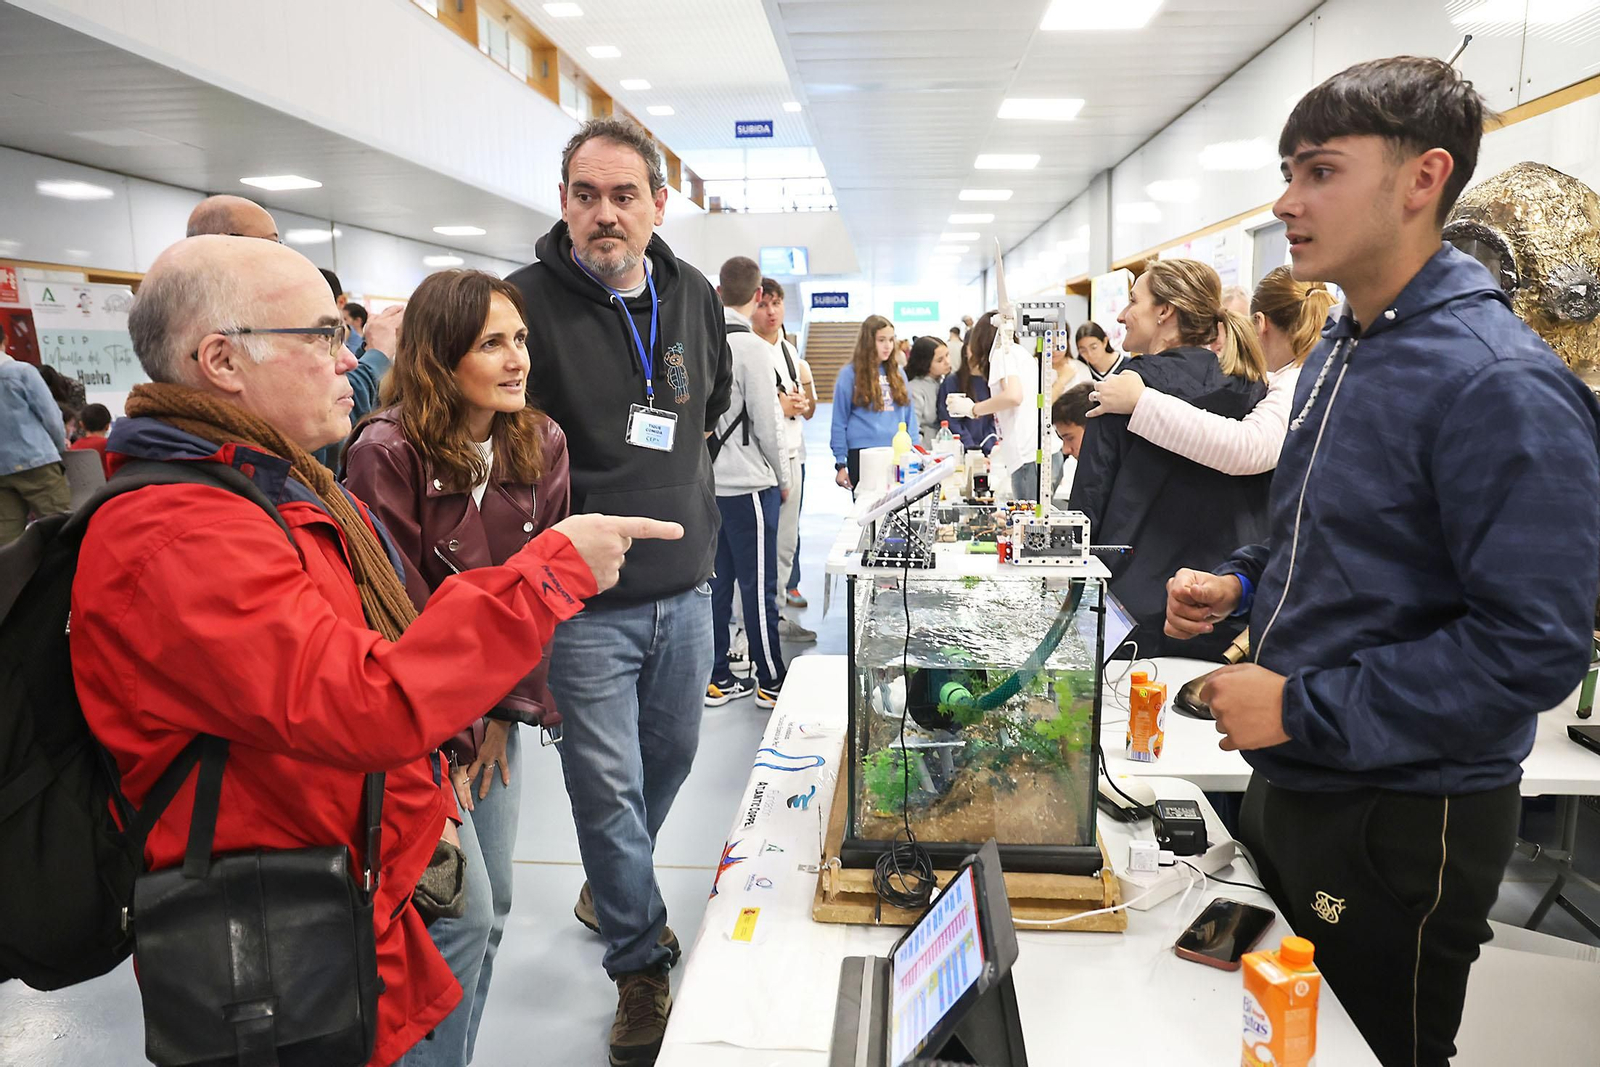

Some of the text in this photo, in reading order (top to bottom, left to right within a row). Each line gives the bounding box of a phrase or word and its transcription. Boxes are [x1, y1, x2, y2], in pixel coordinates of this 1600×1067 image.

[737, 124, 771, 135] SUBIDA
[813, 295, 847, 305] SUBIDA
[900, 307, 932, 316] SALIDA
[77, 369, 111, 386] Huelva
